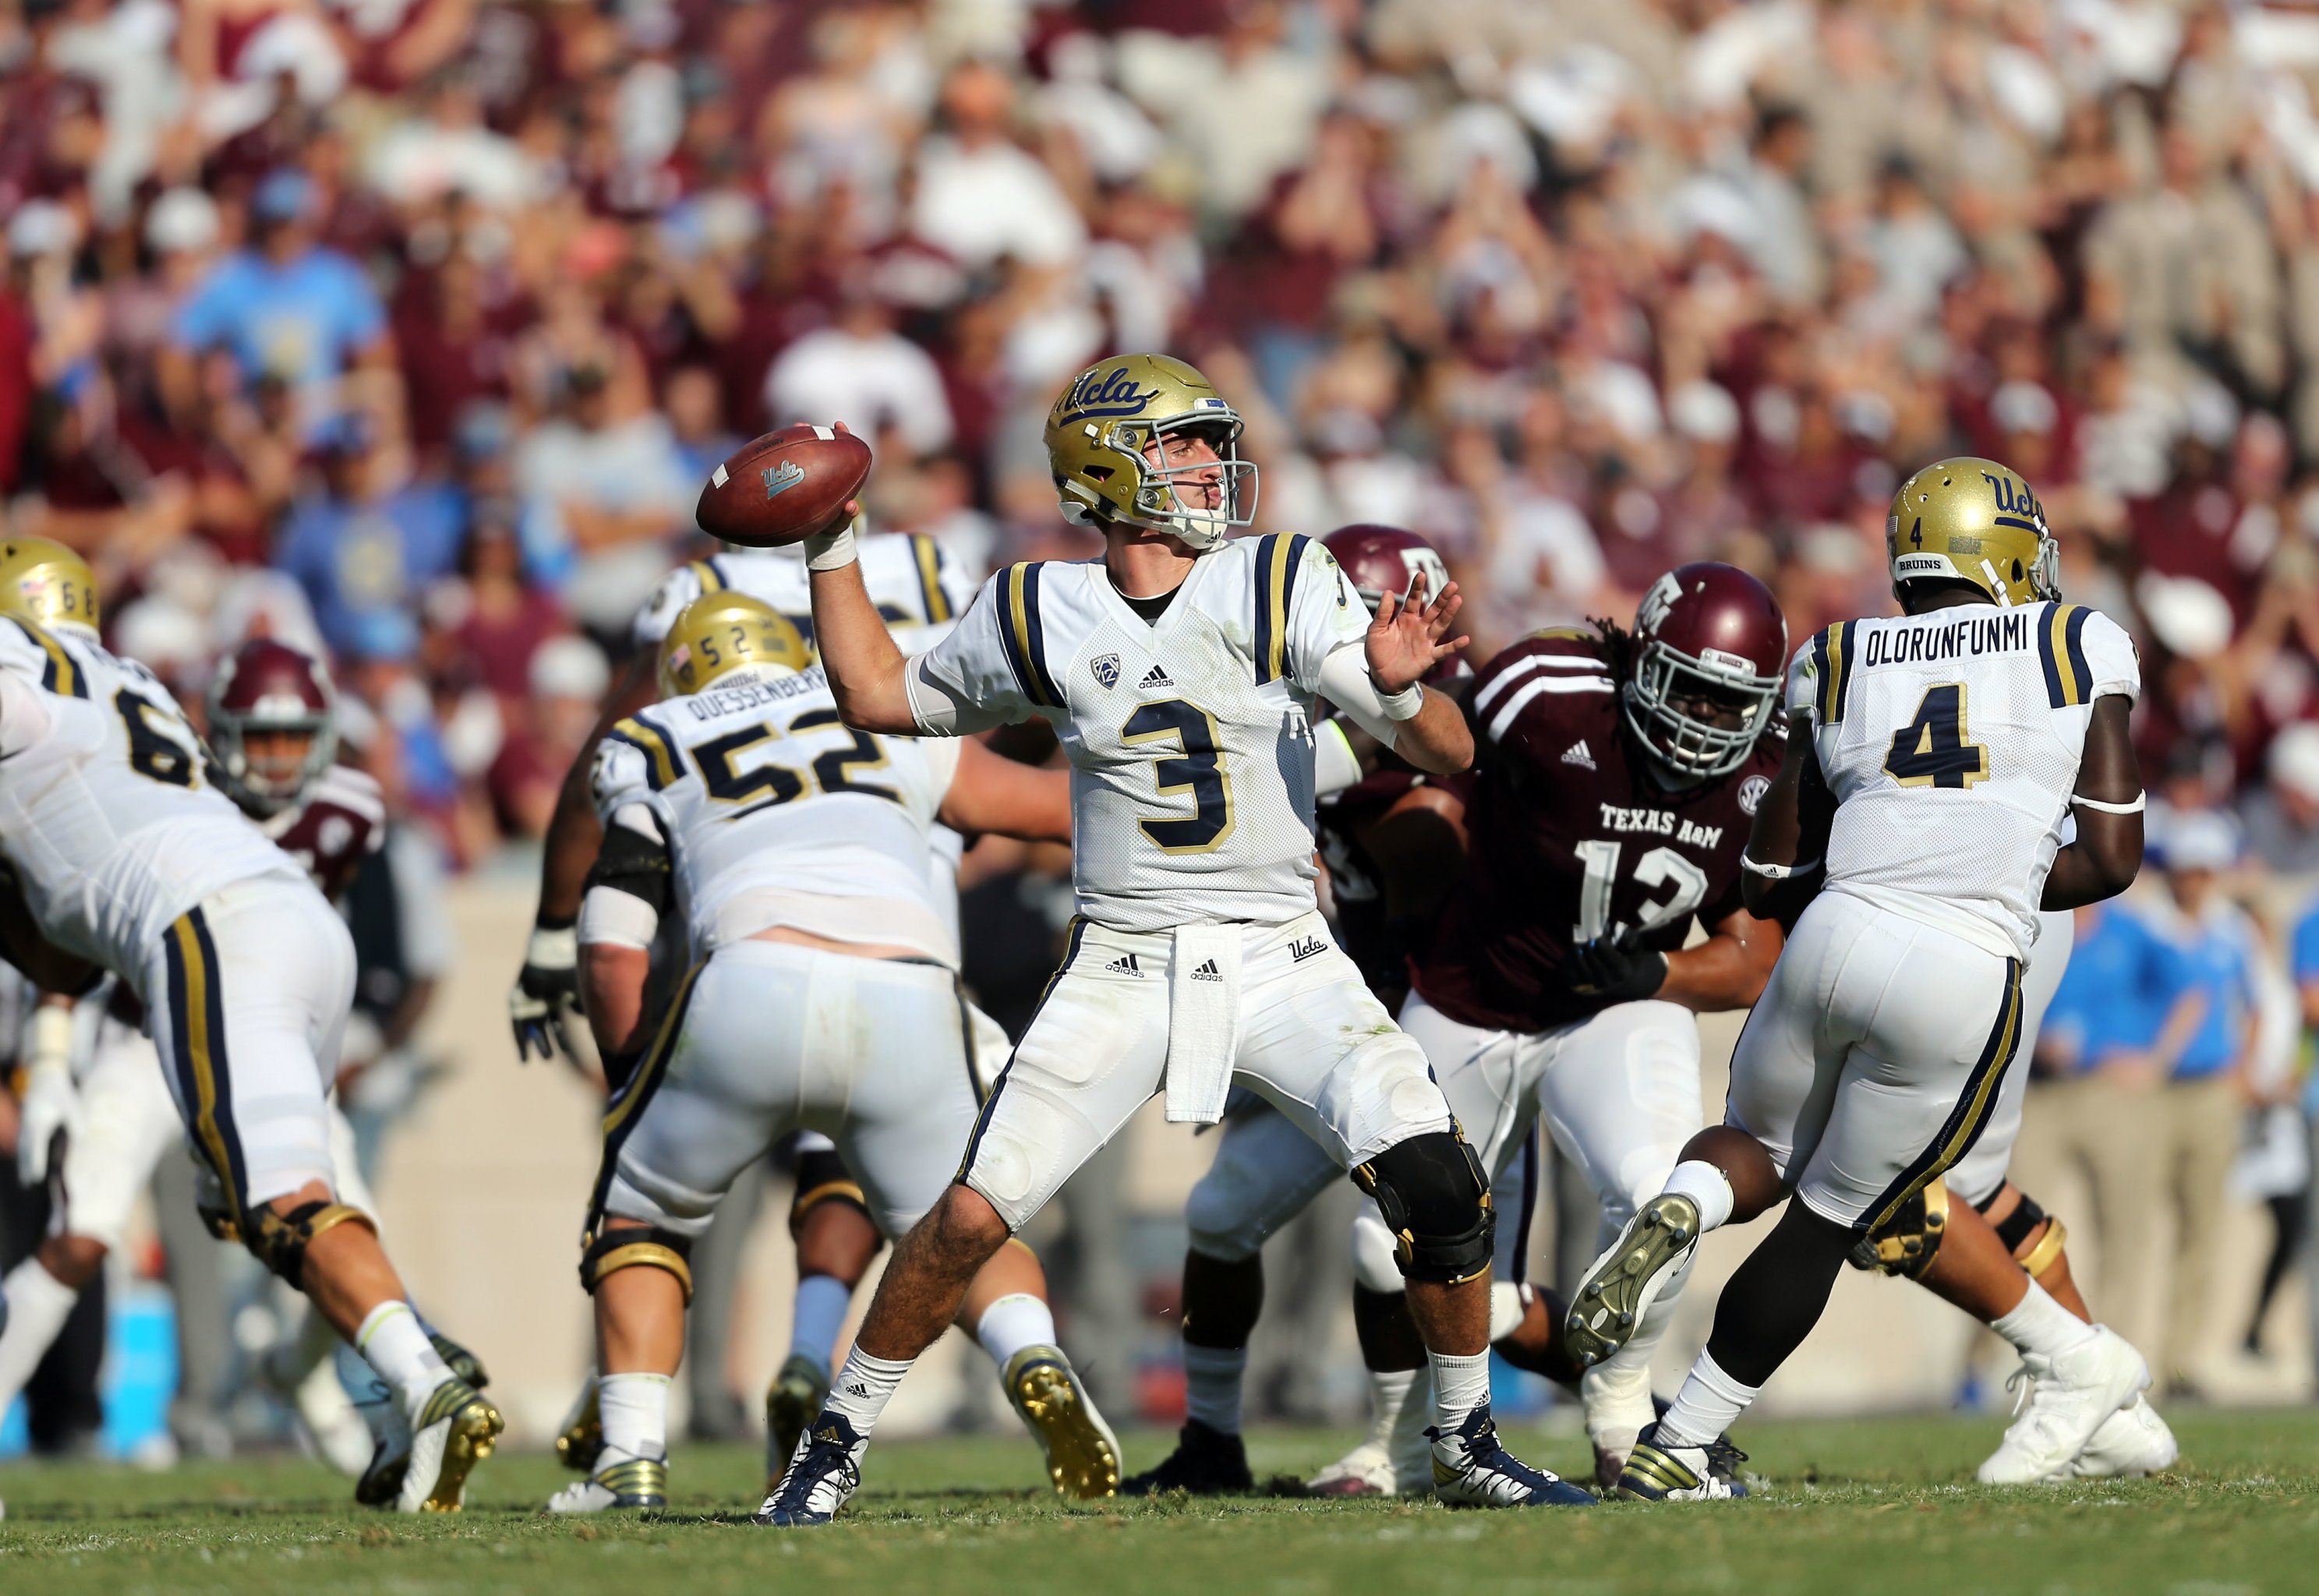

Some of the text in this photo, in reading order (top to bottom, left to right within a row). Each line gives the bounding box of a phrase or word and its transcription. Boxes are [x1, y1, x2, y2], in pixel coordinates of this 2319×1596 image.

[1910, 517, 1922, 550] 4
[1900, 560, 1941, 570] BRUINS
[700, 627, 750, 666] 52
[1865, 613, 2027, 667] OLORUNFUNMI
[1091, 655, 1119, 678] PAC
[1101, 668, 1116, 683] 12
[1139, 677, 1175, 689] adidas
[1882, 682, 1990, 789] 4
[688, 708, 908, 823] 52
[1119, 697, 1236, 856] 3
[1600, 802, 1723, 849] TEXAS A&M
[1289, 935, 1327, 963] Ucla
[1105, 962, 1145, 979] adidas
[1190, 972, 1224, 983] adidas
[846, 1386, 871, 1399] adidas
